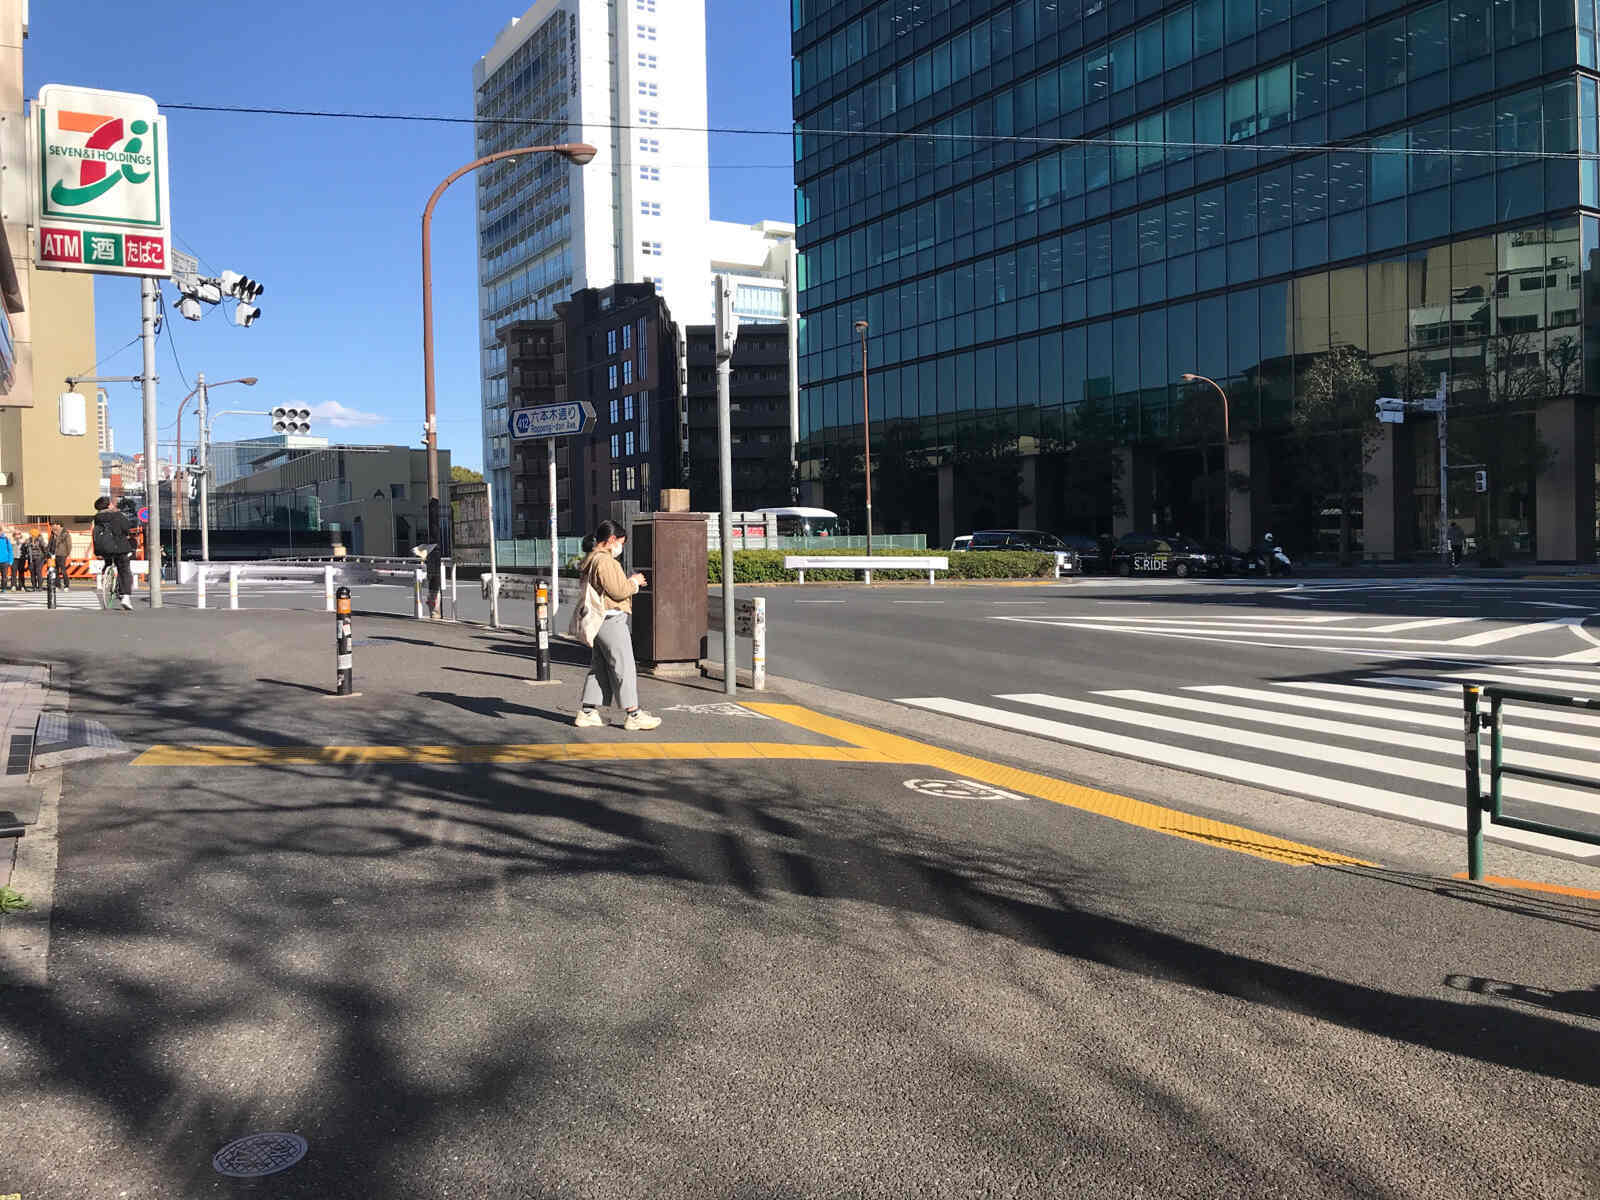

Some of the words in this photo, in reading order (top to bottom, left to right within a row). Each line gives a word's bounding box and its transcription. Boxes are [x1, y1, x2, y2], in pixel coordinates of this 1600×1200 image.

[98, 151, 152, 166] HOLDINGS
[44, 233, 79, 258] ATM
[91, 236, 115, 260] 酒
[127, 240, 163, 264] たばこ
[1134, 559, 1168, 570] S.RIDE
